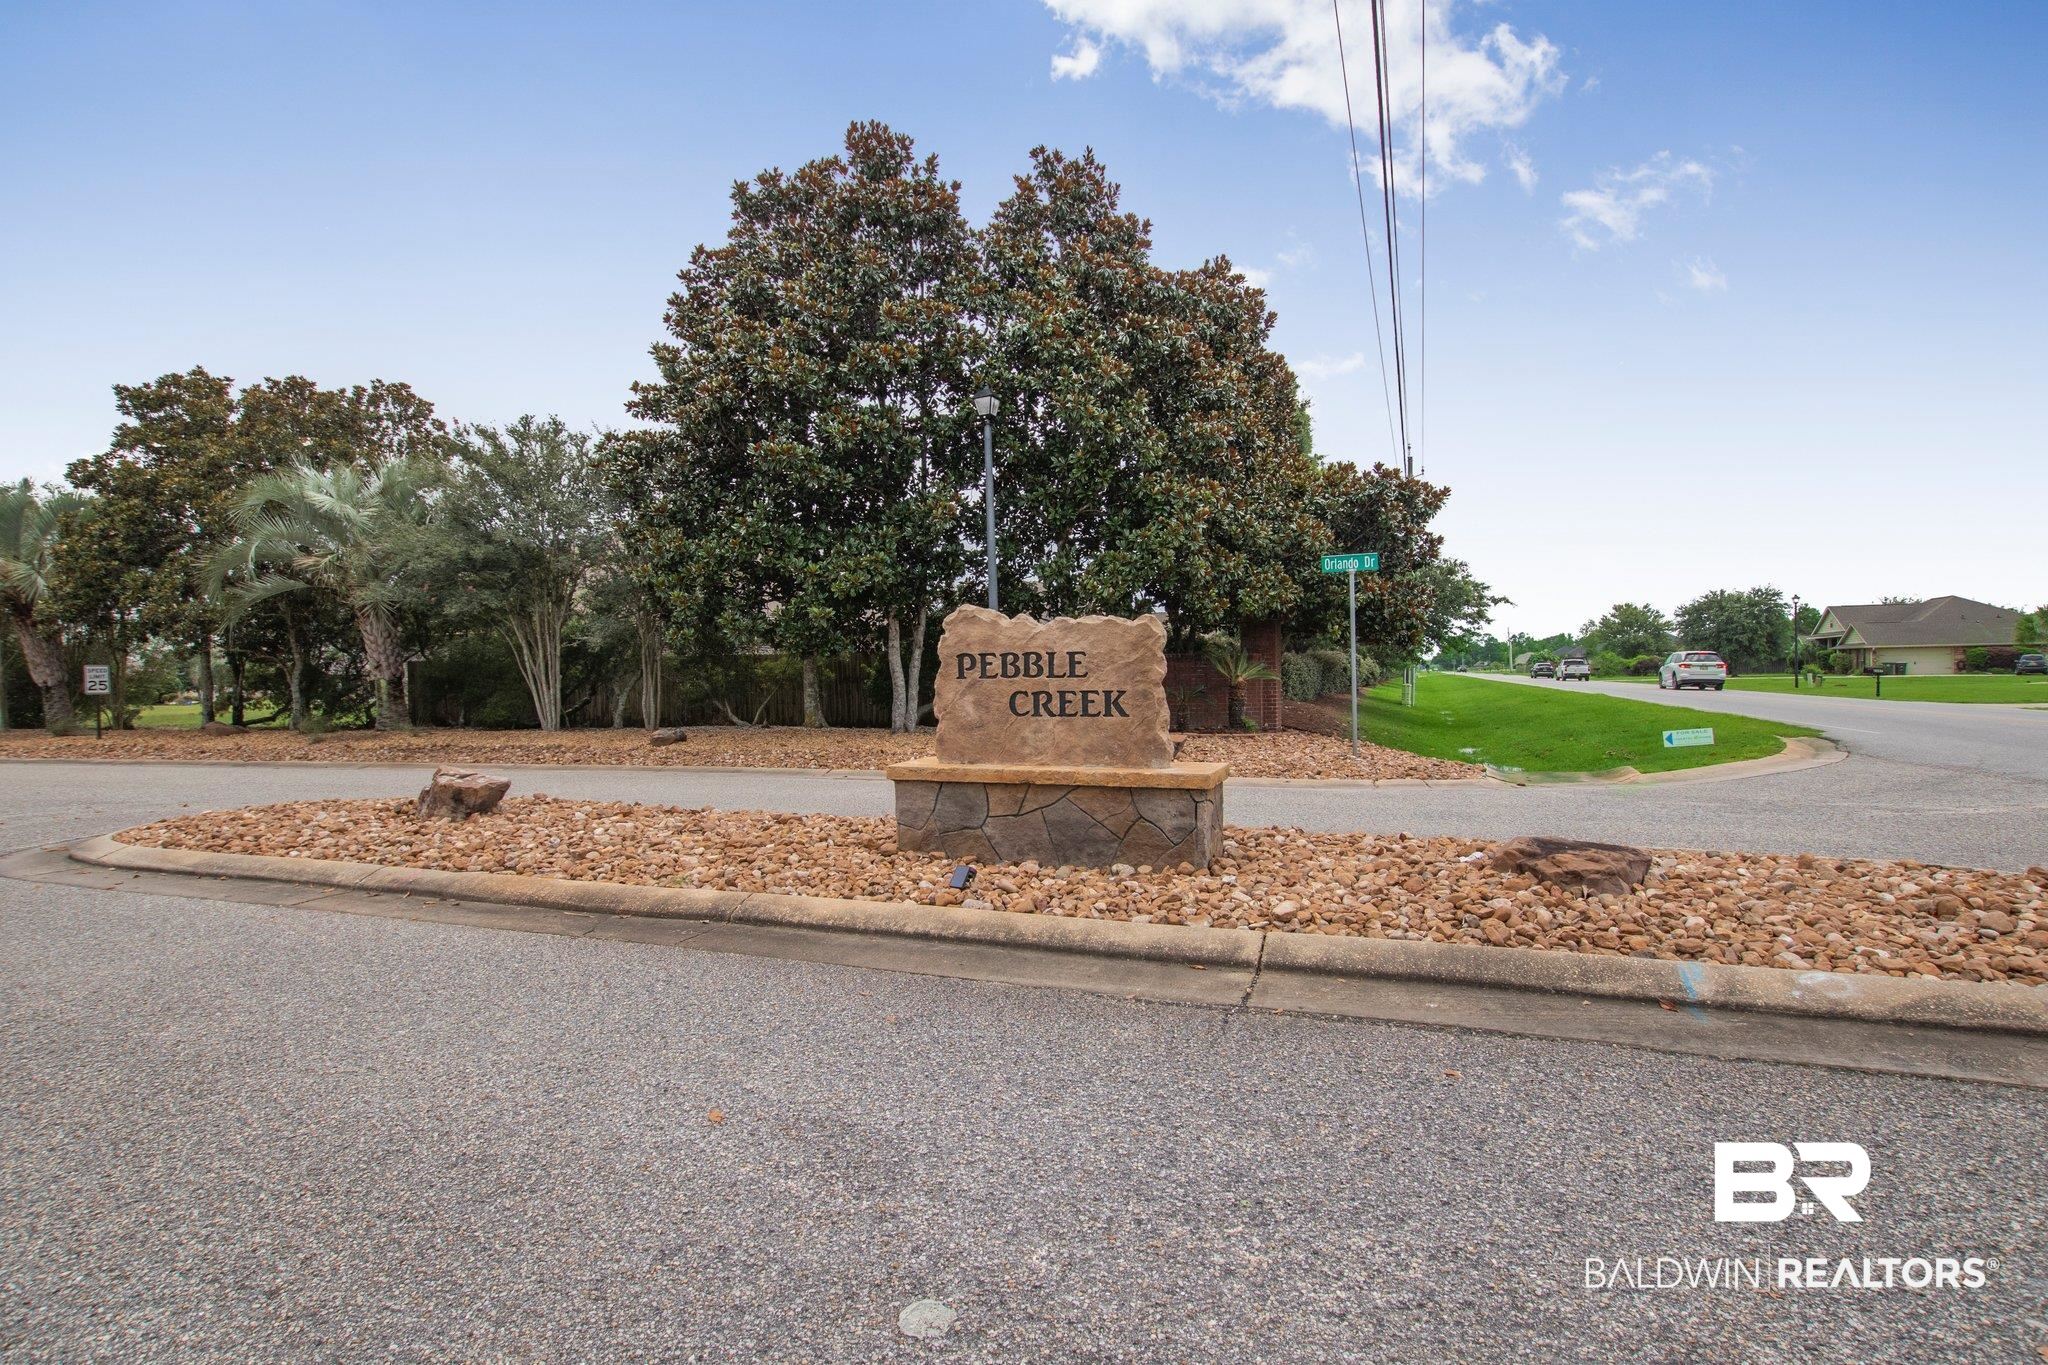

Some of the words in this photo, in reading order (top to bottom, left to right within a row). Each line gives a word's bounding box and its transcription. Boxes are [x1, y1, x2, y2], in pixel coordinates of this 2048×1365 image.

[1324, 557, 1359, 570] Orlando
[1364, 555, 1375, 568] Dr
[956, 651, 1089, 680] PEBBLE
[88, 680, 108, 691] 25
[1009, 690, 1130, 717] CREEK
